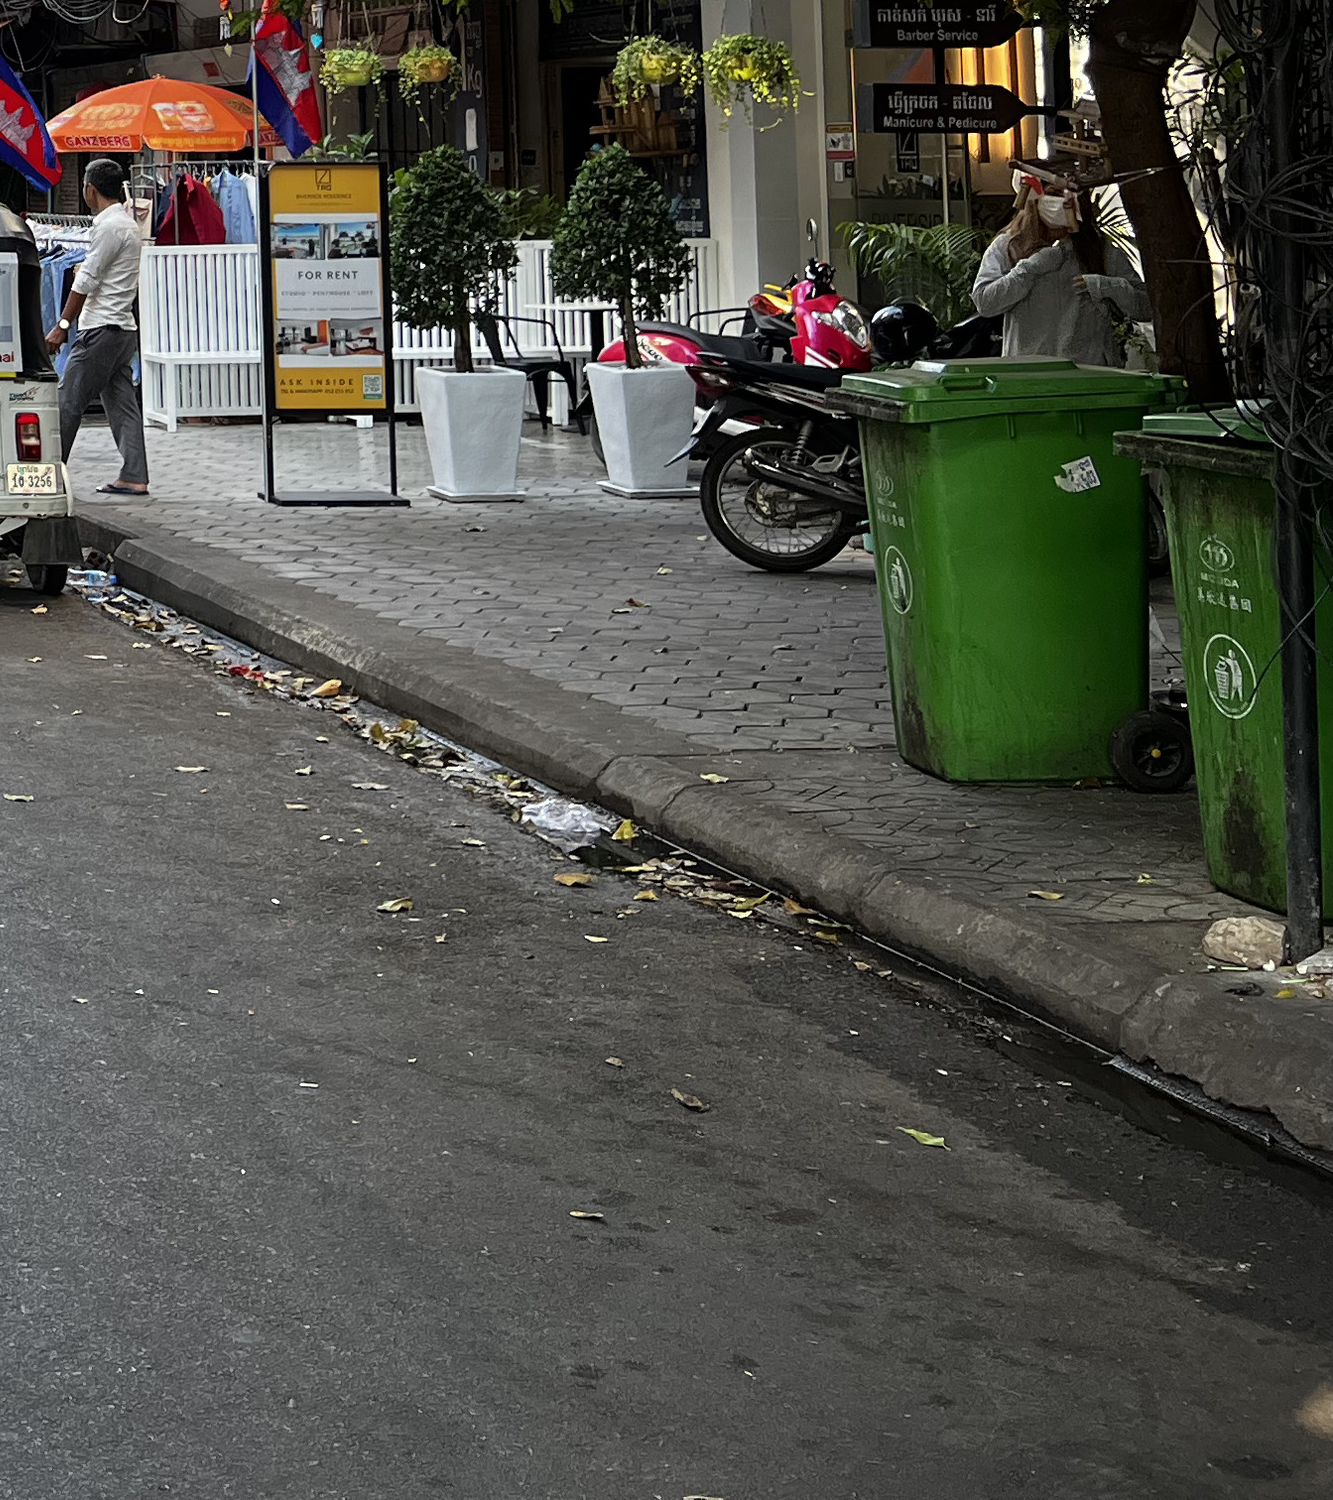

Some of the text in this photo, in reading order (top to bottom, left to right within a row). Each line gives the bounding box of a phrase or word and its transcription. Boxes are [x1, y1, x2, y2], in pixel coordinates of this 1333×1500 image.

[897, 29, 979, 41] Barber Service
[883, 115, 997, 129] Manicure & Pedicure
[66, 136, 130, 147] GANZBERG
[298, 270, 358, 280] FOR RENT
[279, 378, 354, 386] ASK INSIDE
